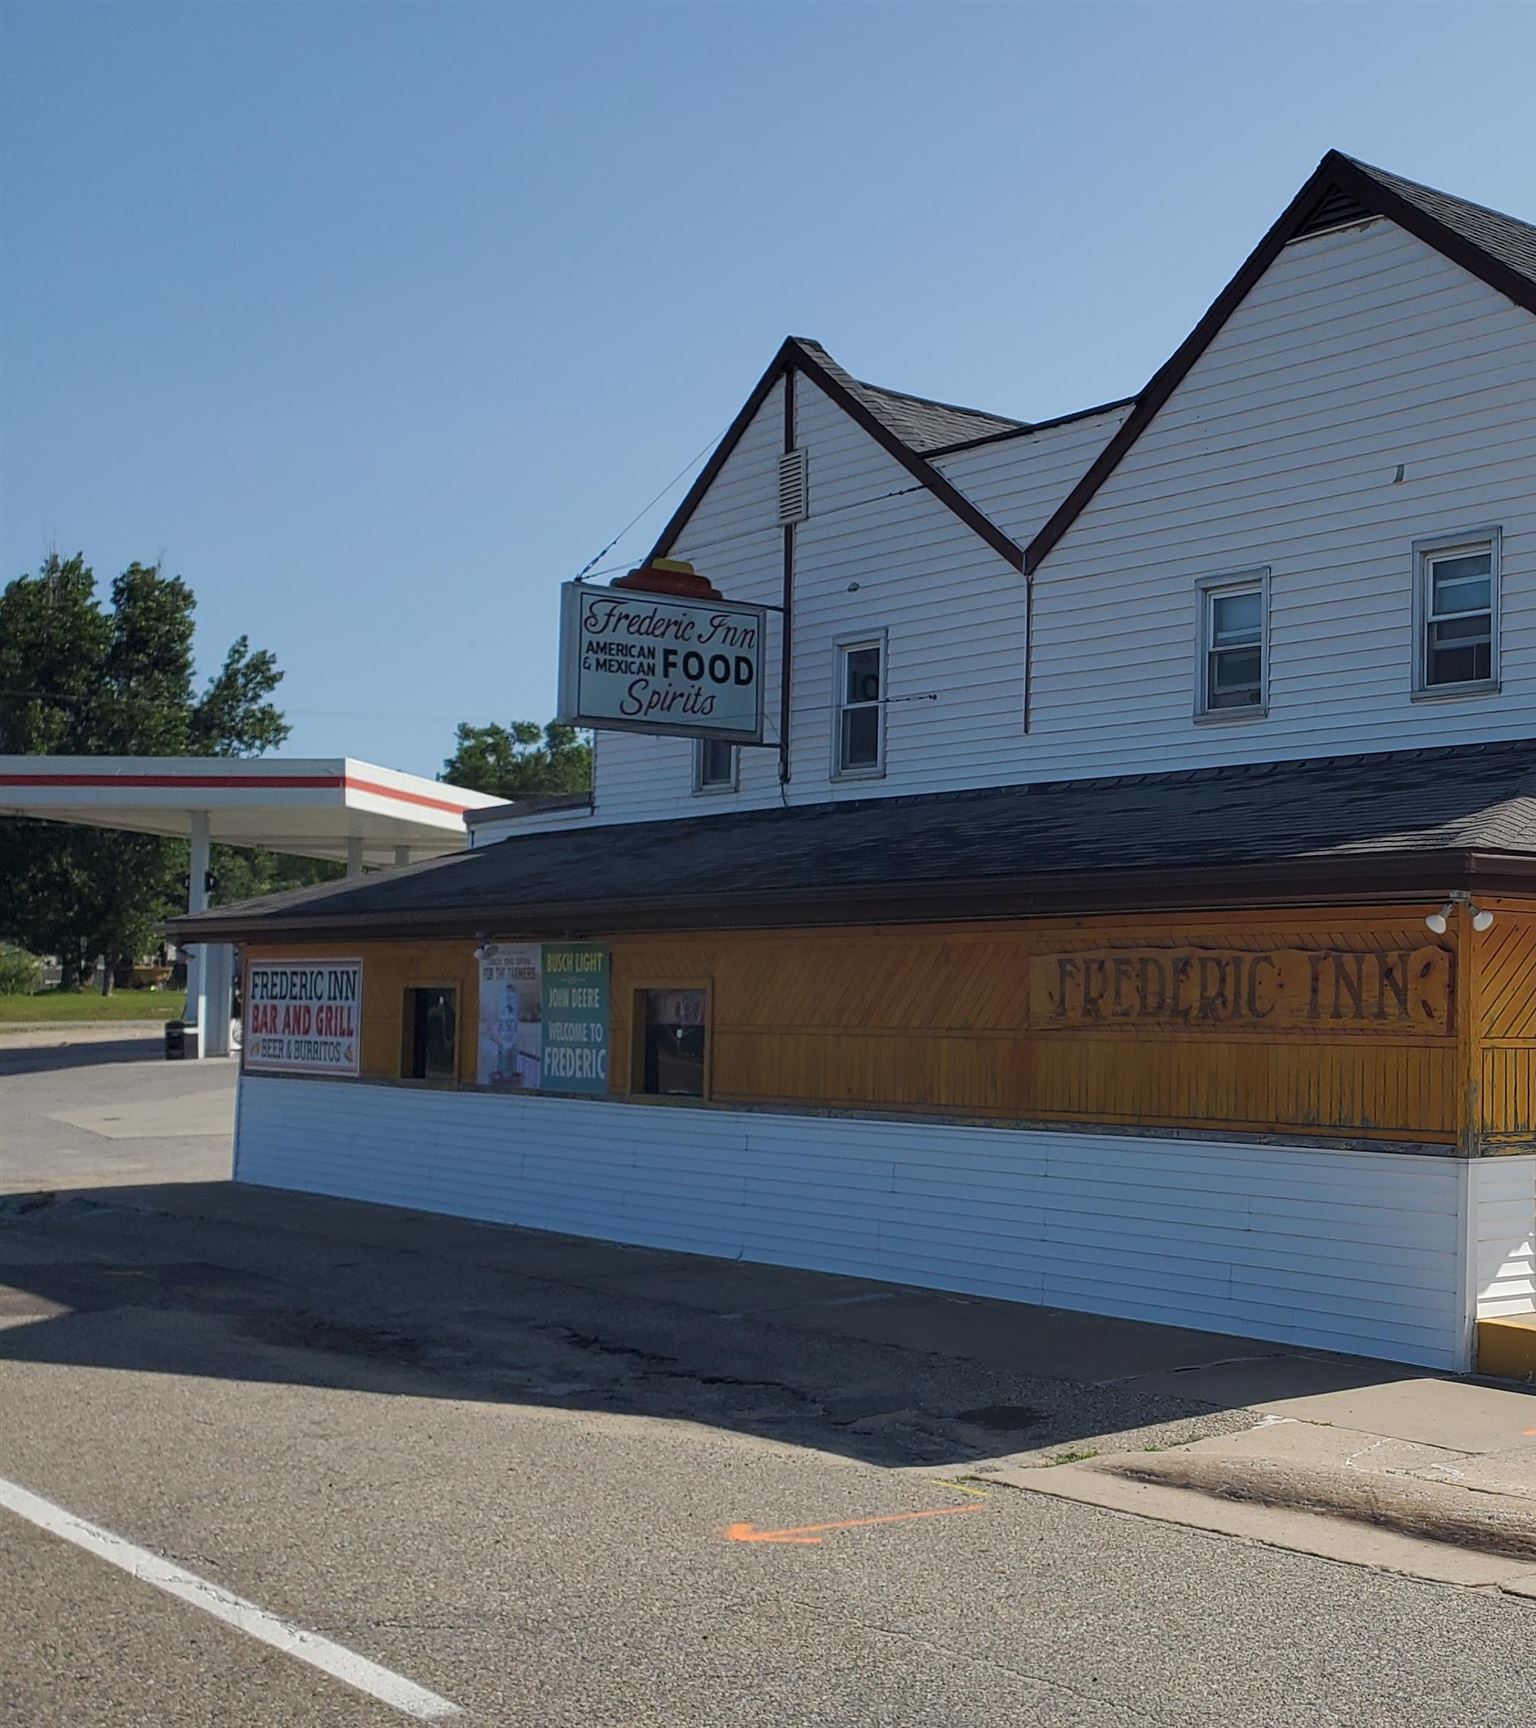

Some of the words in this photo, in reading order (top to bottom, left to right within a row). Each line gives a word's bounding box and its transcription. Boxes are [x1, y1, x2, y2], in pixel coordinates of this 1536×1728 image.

[583, 599, 696, 642] Frederic
[697, 613, 756, 650] Inn
[582, 656, 591, 671] &
[595, 658, 656, 677] MEXICAN
[585, 640, 657, 660] AMERICAN
[662, 648, 754, 686] FOOD
[619, 678, 717, 717] Spirits
[546, 952, 574, 973] BUSCH
[575, 952, 604, 973] LIGHT
[251, 970, 324, 1001] FREDERIC
[327, 969, 358, 1002] INN
[548, 988, 569, 1008] JOHN
[571, 988, 600, 1009] DEERE
[1054, 955, 1278, 1022] FREDERIC
[1305, 953, 1415, 1021] INN
[251, 1004, 278, 1035] BAR
[282, 1005, 312, 1036] AND
[316, 1005, 354, 1038] GRILL
[548, 1022, 588, 1042] WELCOME
[590, 1023, 603, 1043] TO
[261, 1038, 284, 1059] BEER
[286, 1039, 292, 1059] &
[294, 1040, 341, 1063] BURRITOS
[544, 1047, 607, 1080] FREDERIC
